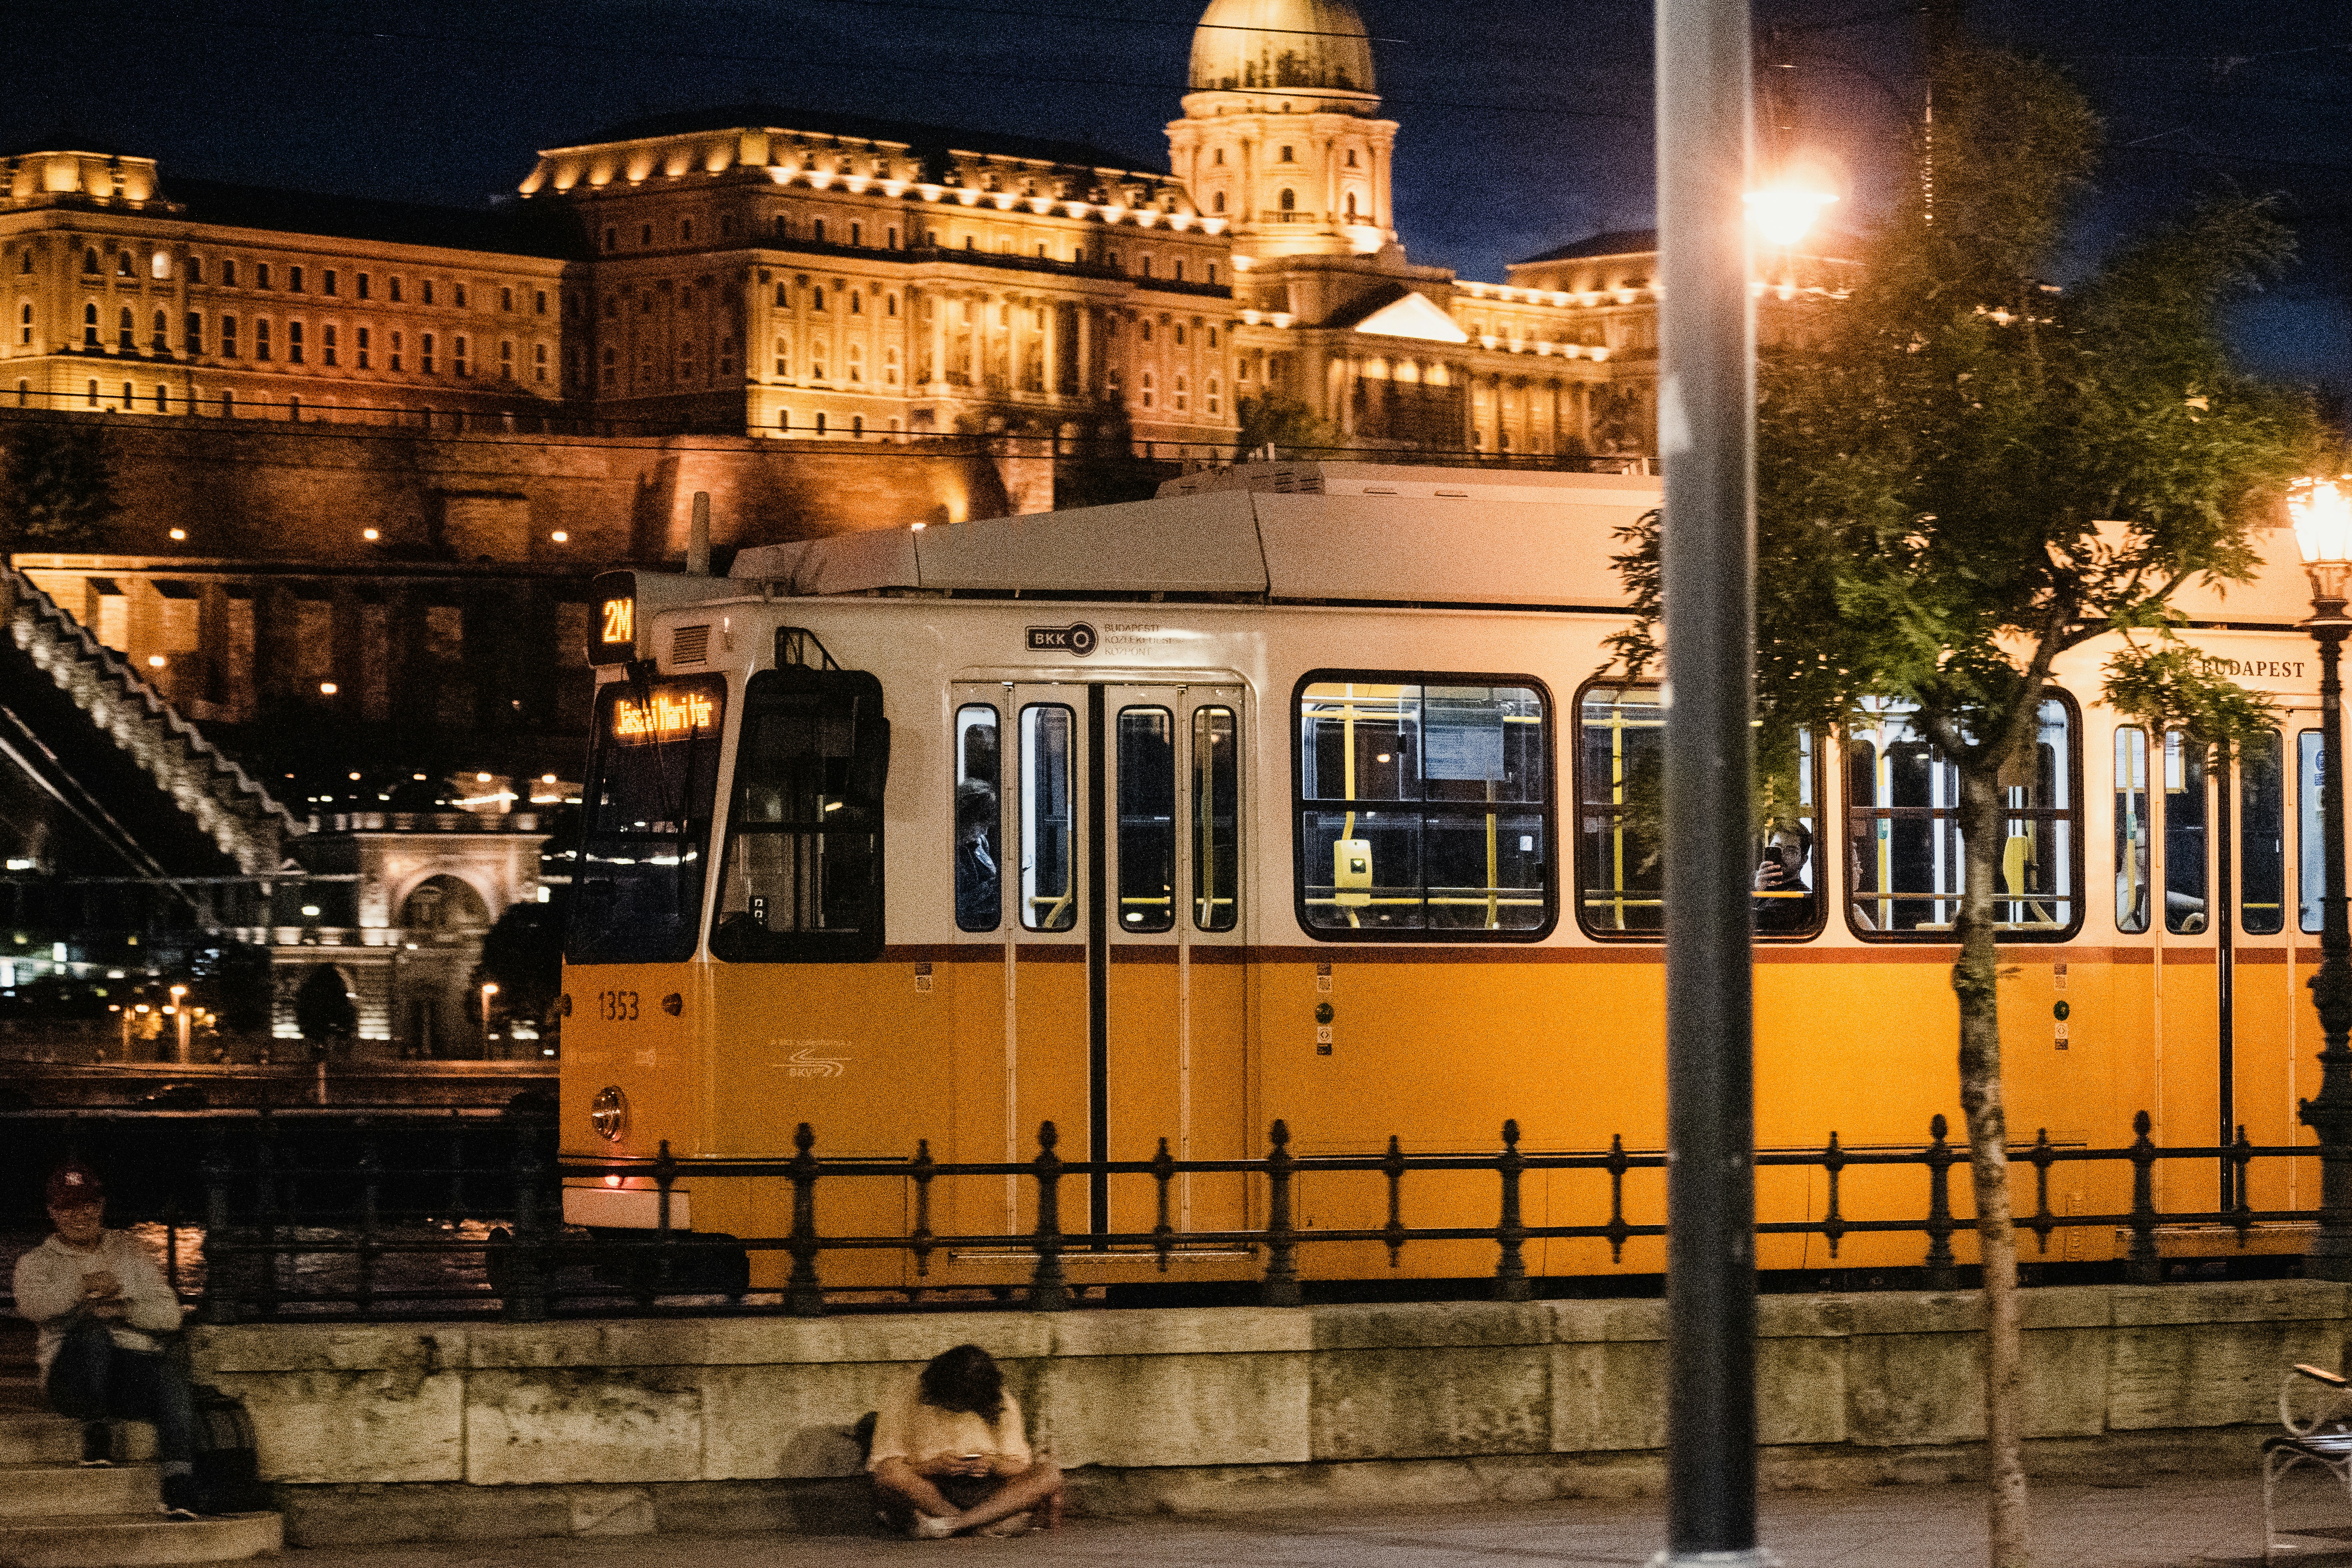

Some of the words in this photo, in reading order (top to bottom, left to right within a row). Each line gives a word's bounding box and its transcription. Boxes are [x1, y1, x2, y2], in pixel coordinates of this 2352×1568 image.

[603, 599, 632, 642] 2M
[1036, 634, 1066, 645] BKK
[2202, 659, 2304, 678] BUDAPEST
[599, 991, 639, 1021] 1353
